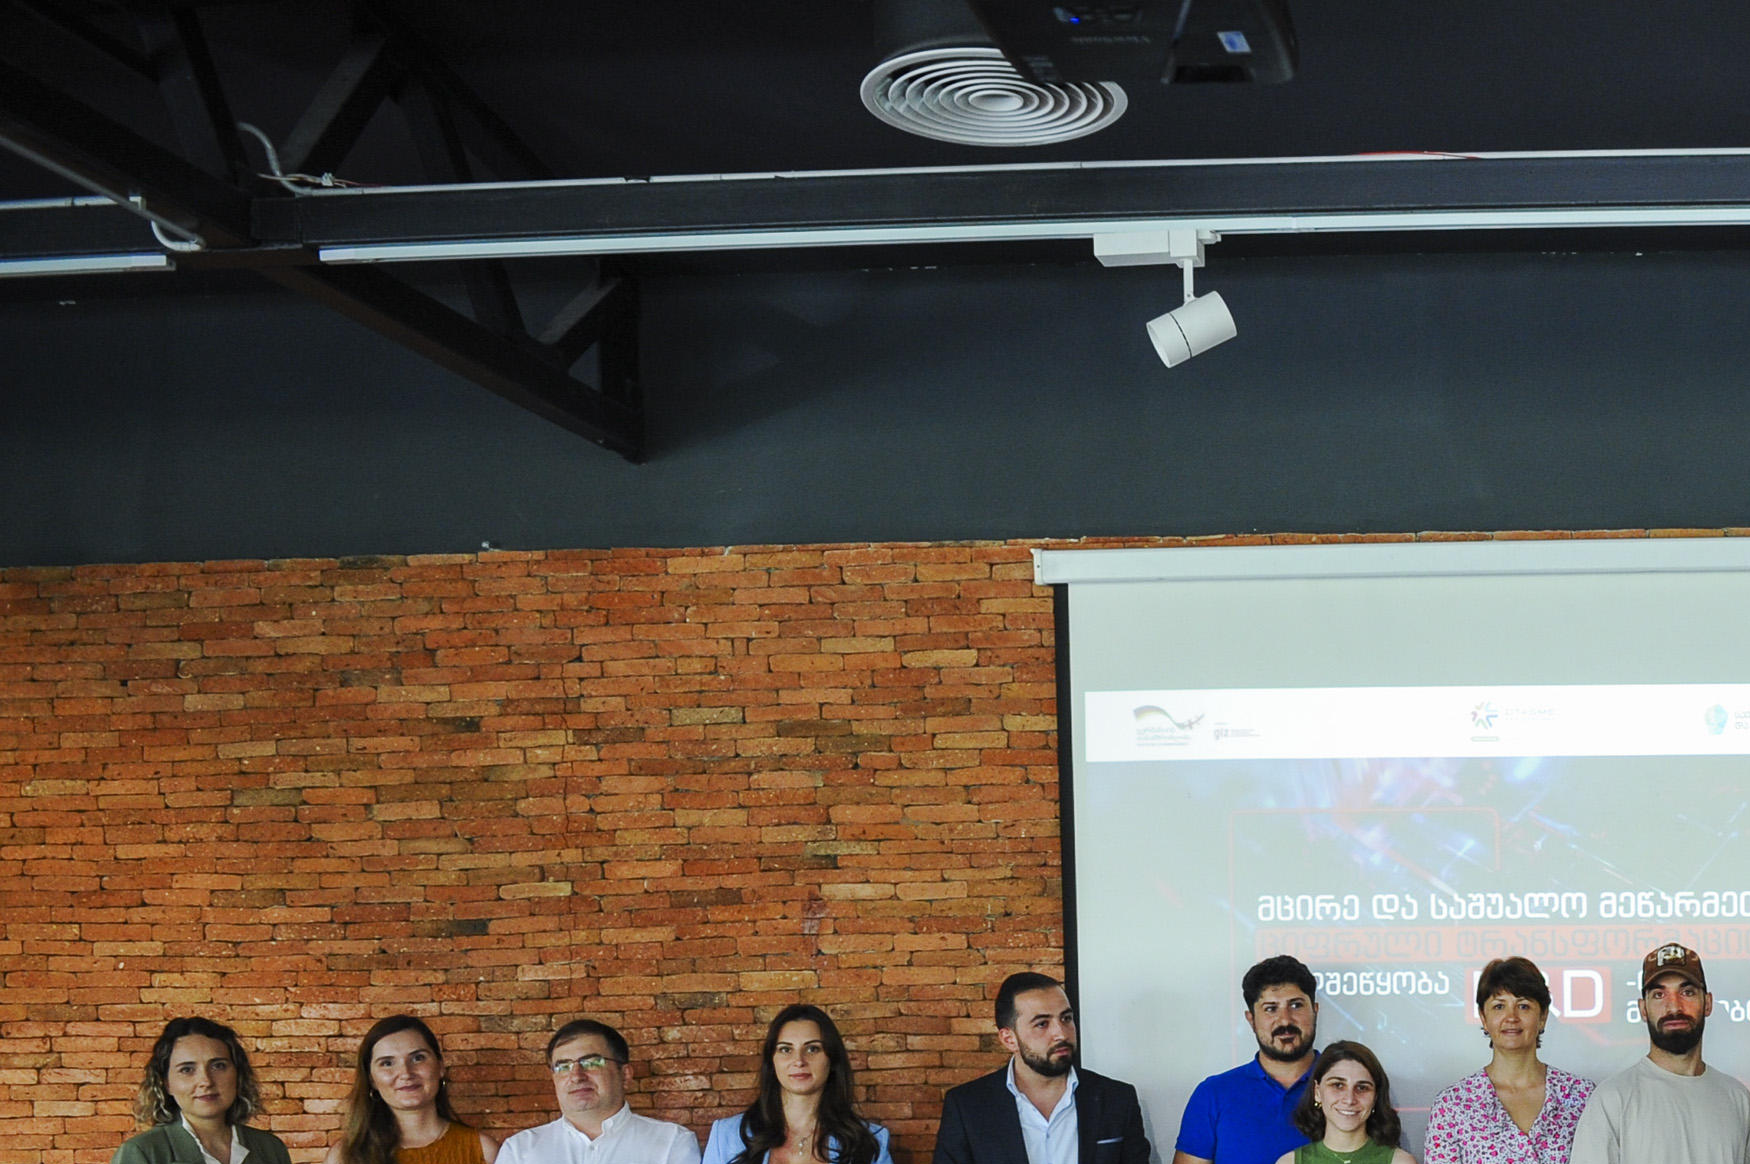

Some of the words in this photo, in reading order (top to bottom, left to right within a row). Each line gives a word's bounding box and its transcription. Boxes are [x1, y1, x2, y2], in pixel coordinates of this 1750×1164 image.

[1257, 895, 1360, 921] მცირე
[1372, 894, 1418, 920] და
[1430, 892, 1588, 920] საშუალო
